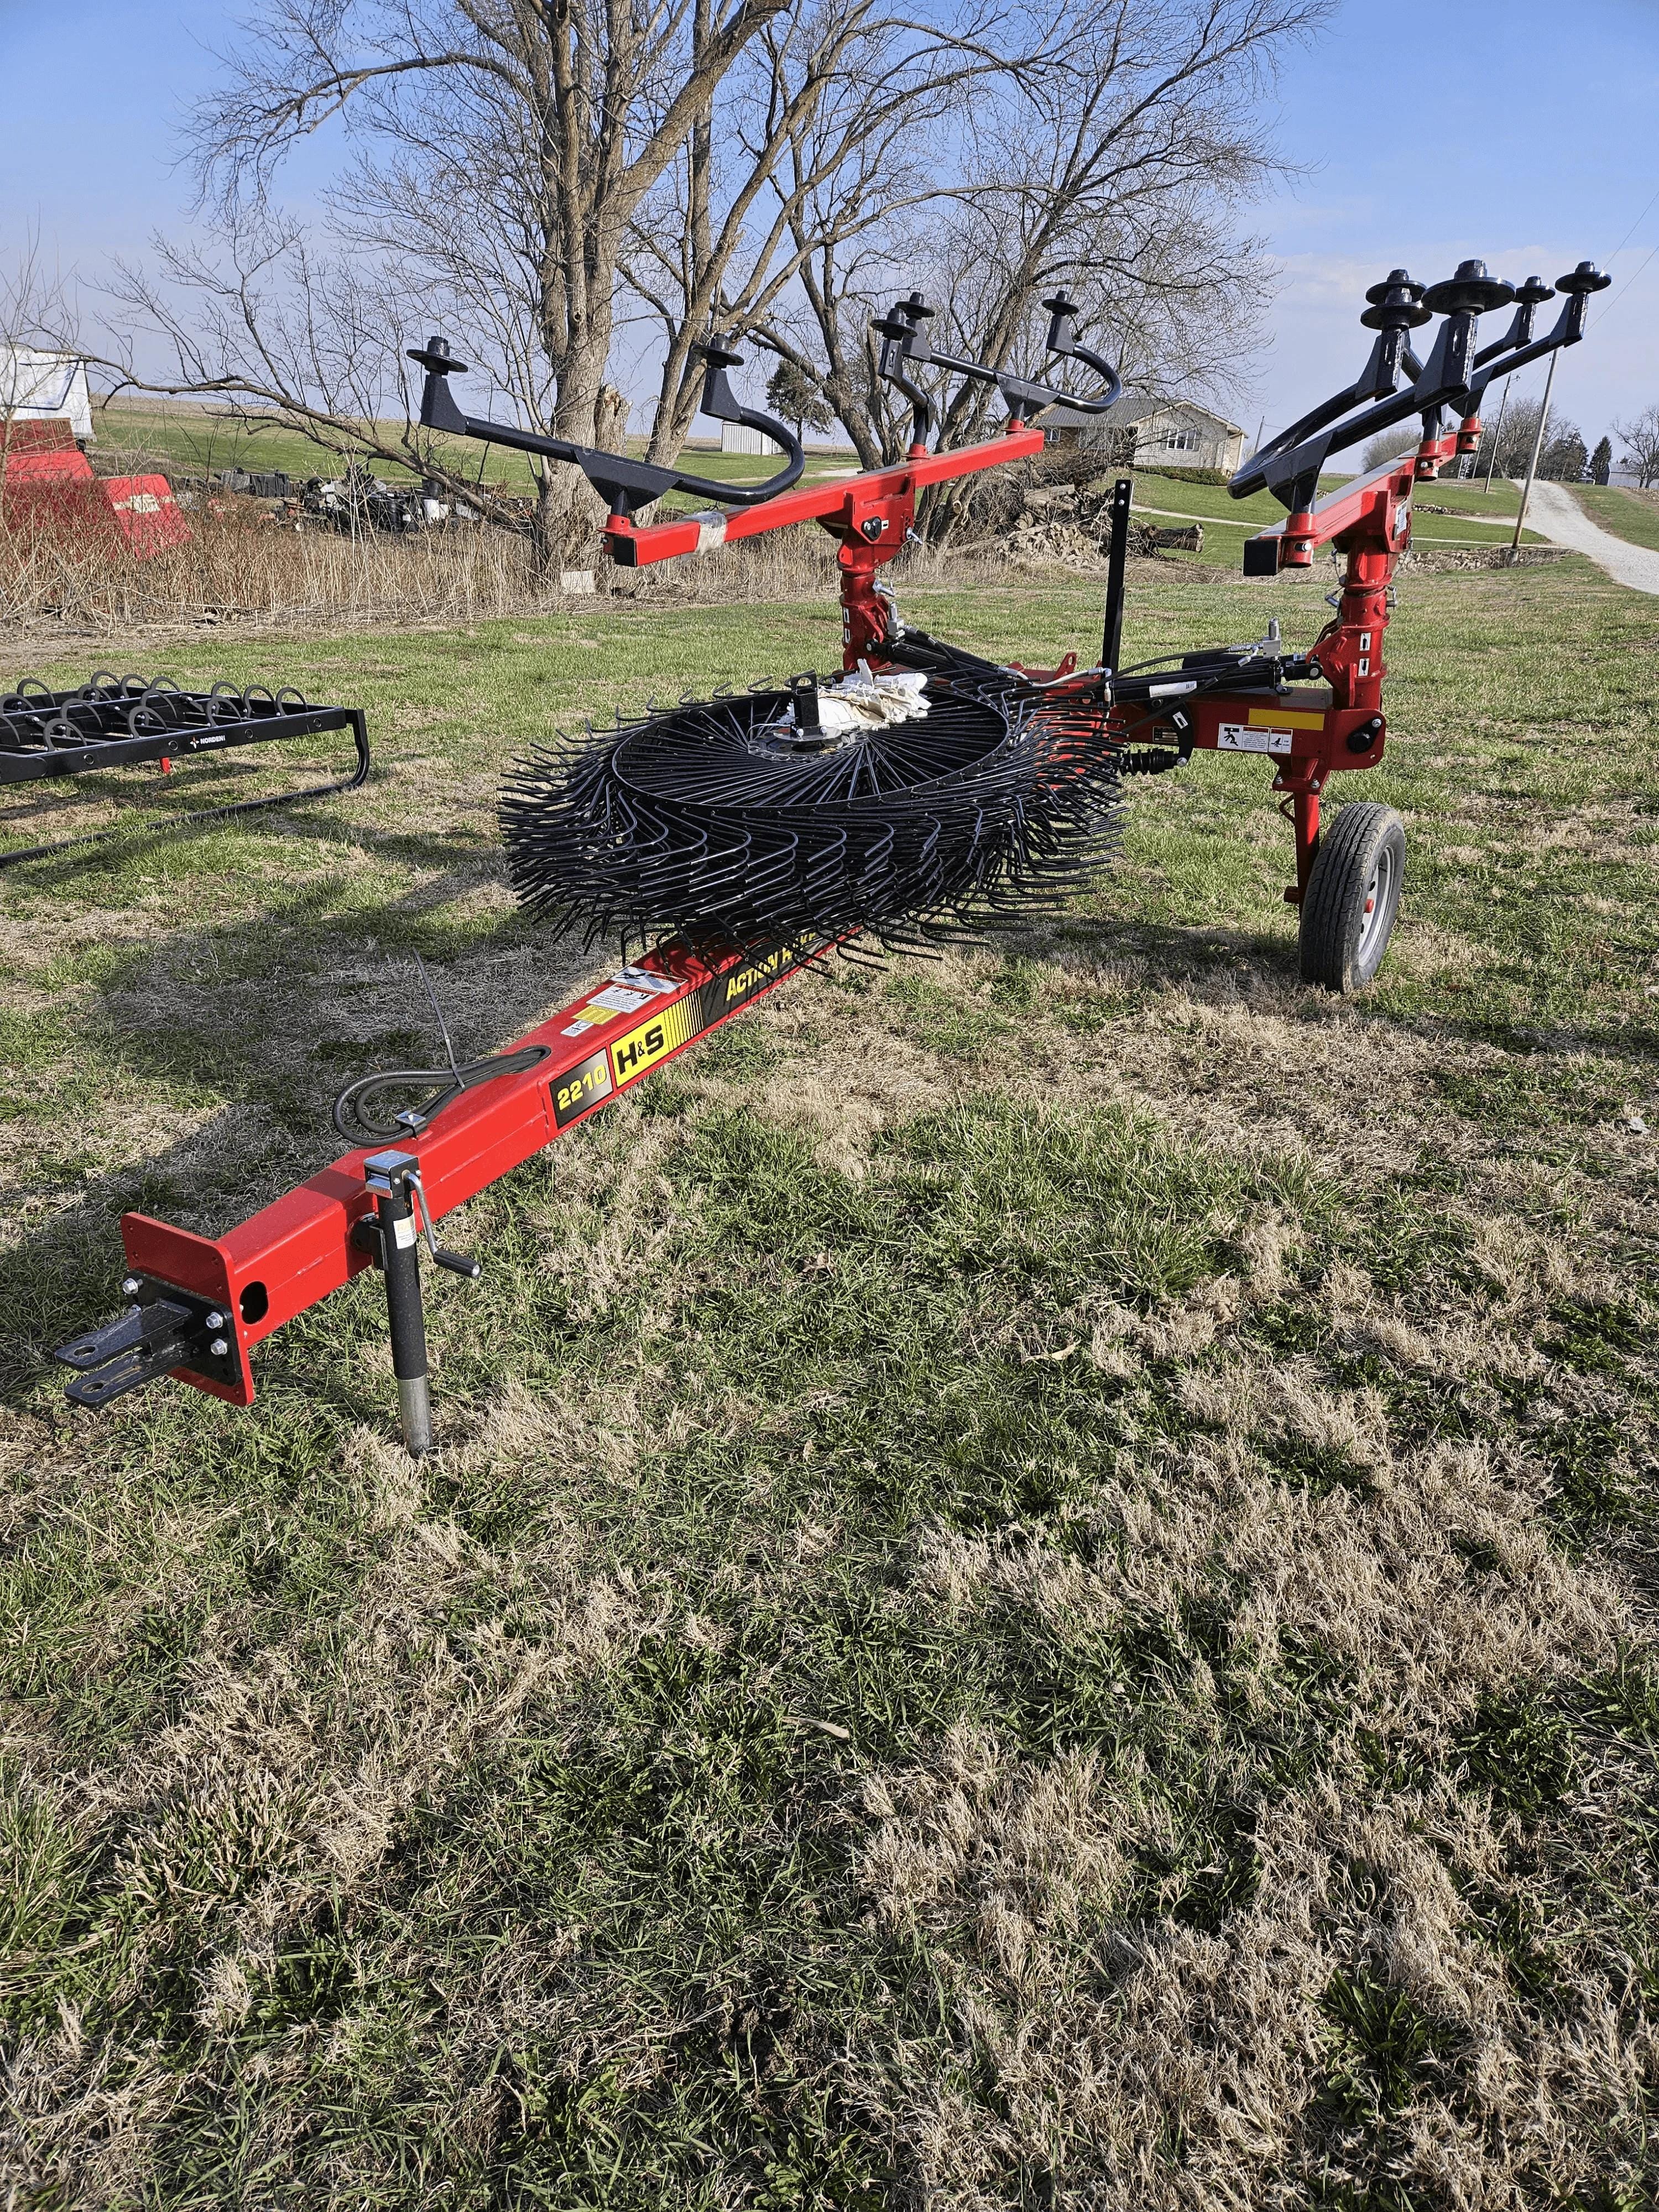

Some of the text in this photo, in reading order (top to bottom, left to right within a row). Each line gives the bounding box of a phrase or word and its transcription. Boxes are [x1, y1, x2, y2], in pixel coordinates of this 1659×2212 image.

[726, 951, 778, 1001] ACTION
[616, 1024, 664, 1075] H&S
[557, 1064, 607, 1111] 2210
